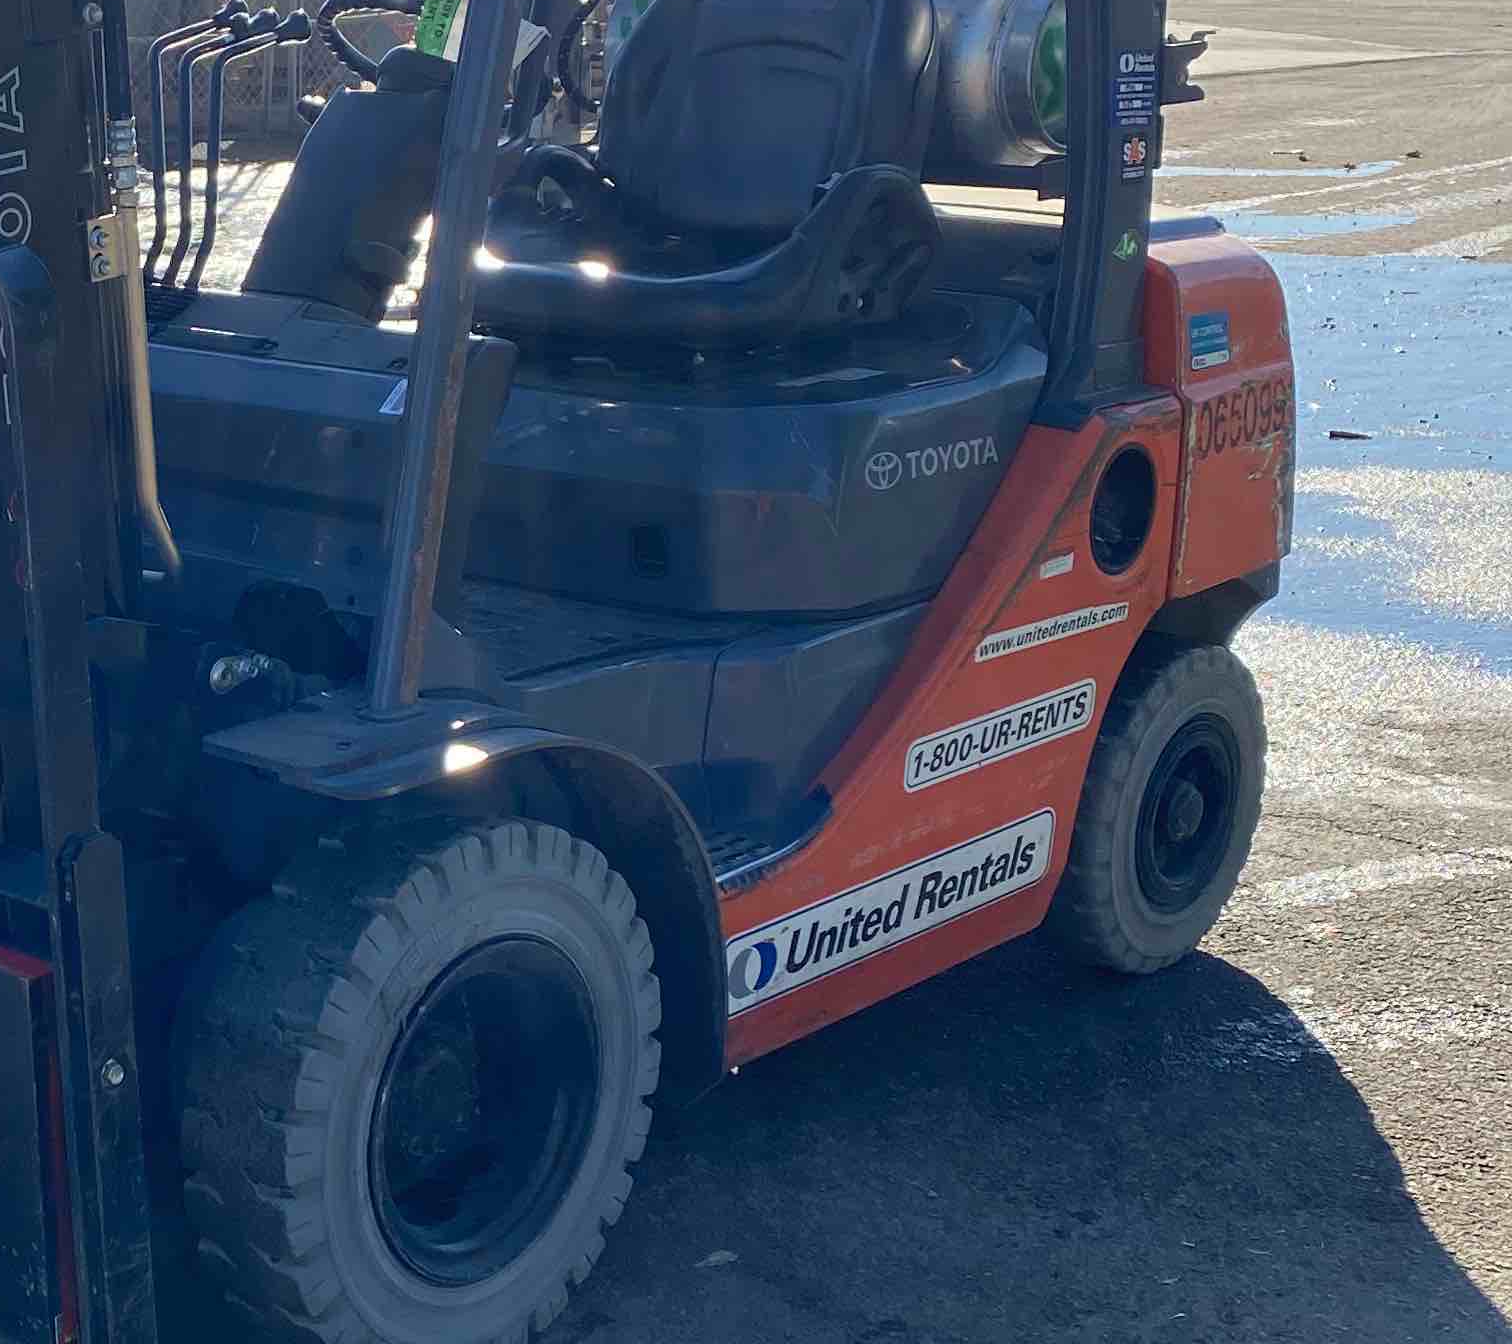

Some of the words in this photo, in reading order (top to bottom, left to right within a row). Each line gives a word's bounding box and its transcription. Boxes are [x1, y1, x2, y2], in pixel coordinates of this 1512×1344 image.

[905, 436, 999, 479] TOYOTA
[979, 604, 1128, 657] www.unitedrentals.com
[914, 691, 1087, 778] 1-800-UR-RENTS
[785, 884, 910, 974] United
[914, 835, 1036, 920] Rentals
